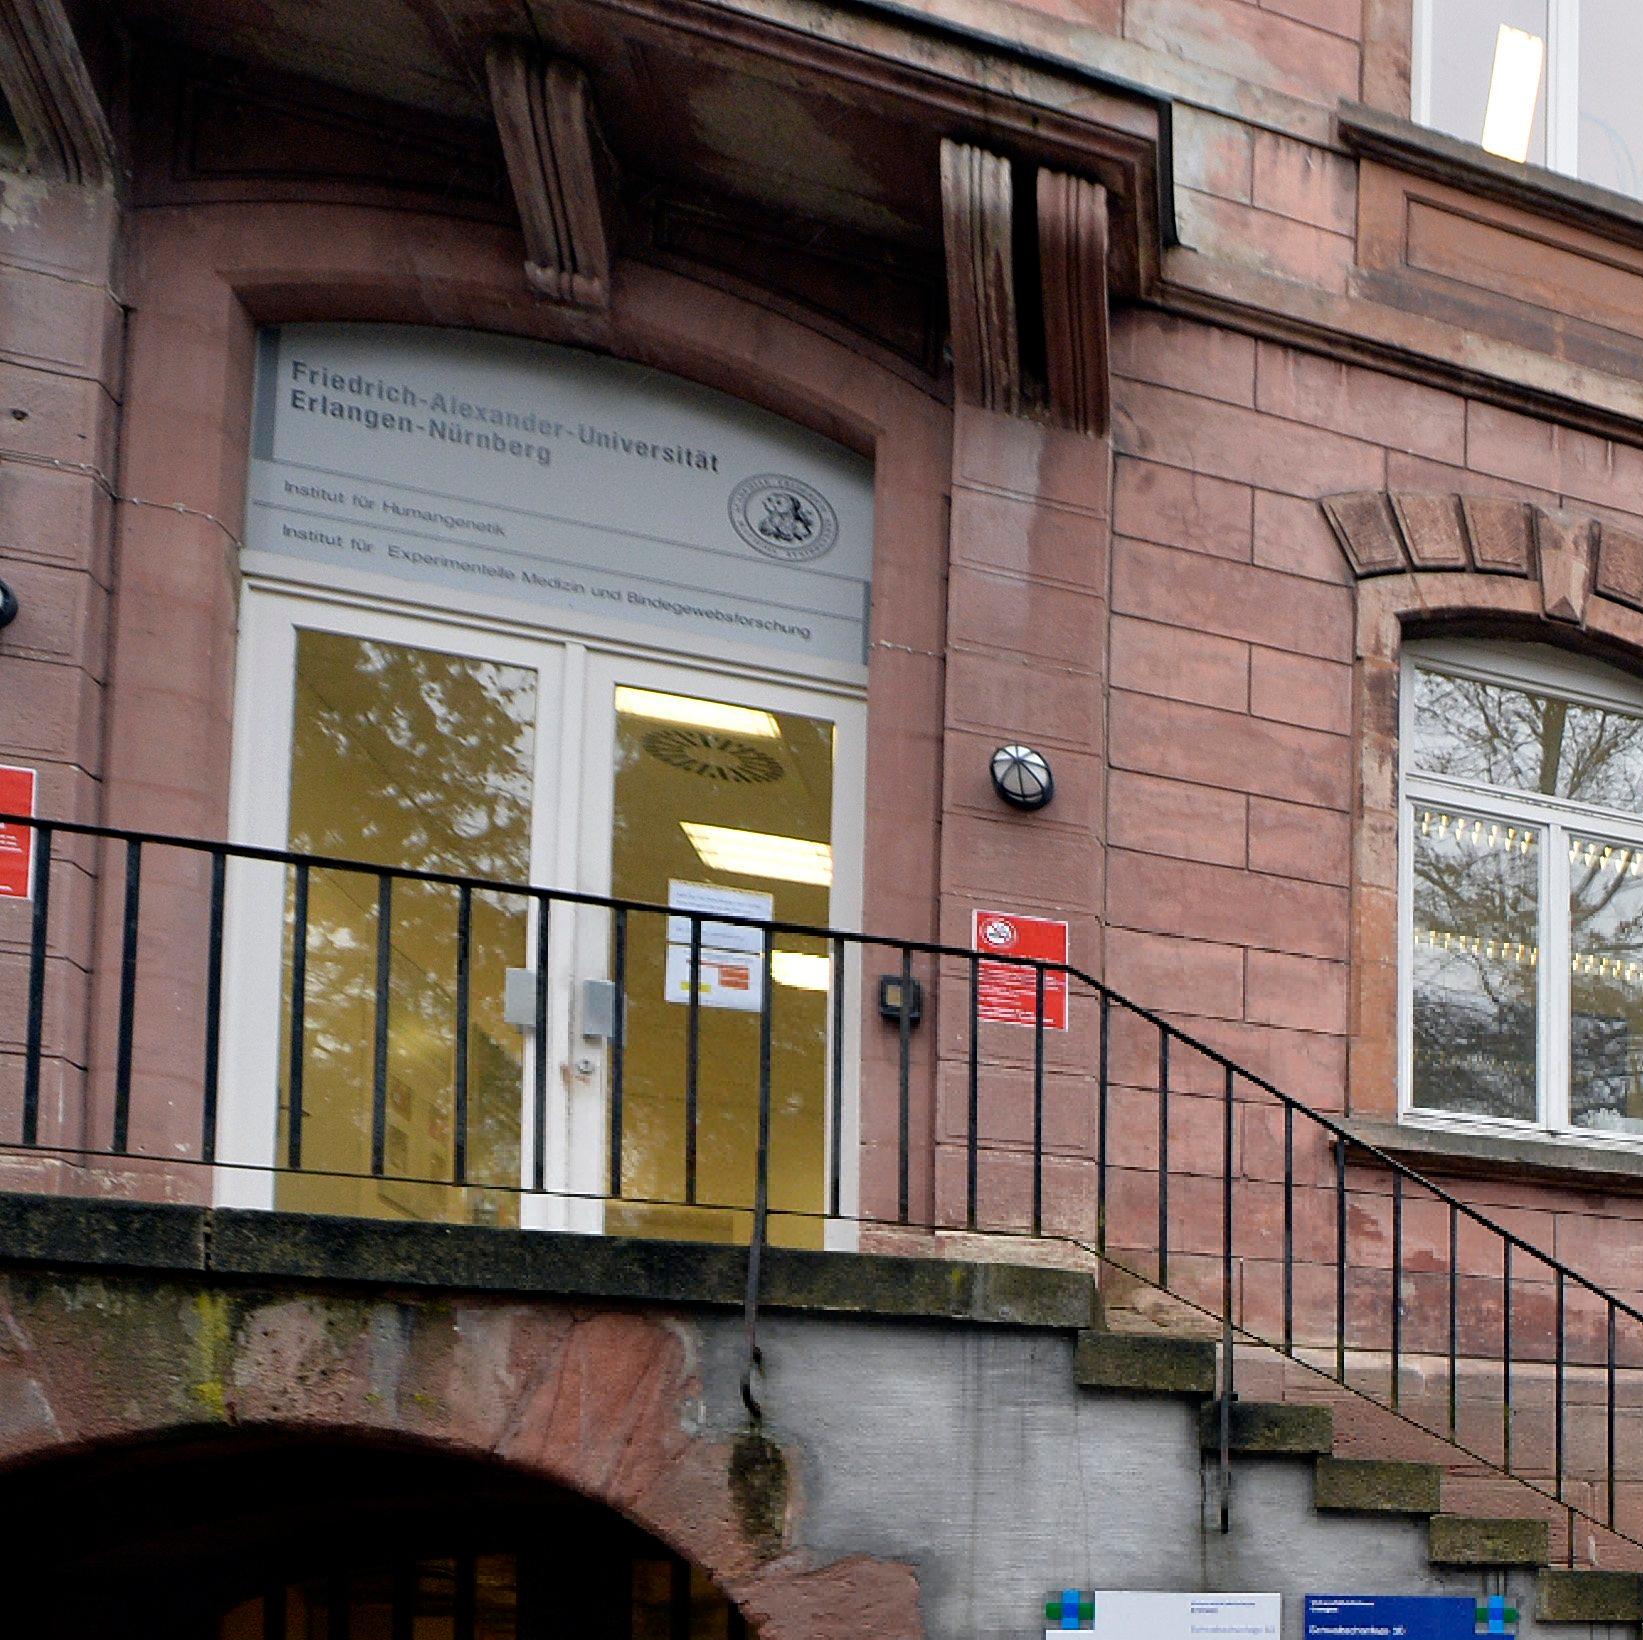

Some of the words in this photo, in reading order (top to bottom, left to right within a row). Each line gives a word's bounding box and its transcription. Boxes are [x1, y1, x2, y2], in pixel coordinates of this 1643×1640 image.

[290, 389, 552, 466] Erlangen-Nürnberg
[291, 360, 719, 473] Friedrich-Alexander-Universität
[284, 480, 344, 504] Institut
[351, 494, 375, 510] für
[382, 500, 506, 537] Humangenetik
[282, 523, 344, 548] Institut
[350, 537, 374, 553] für
[387, 544, 516, 580] Experimentelle
[520, 571, 586, 594] Medizin
[591, 588, 622, 603] und
[627, 590, 811, 640] Bindegewebsforschung
